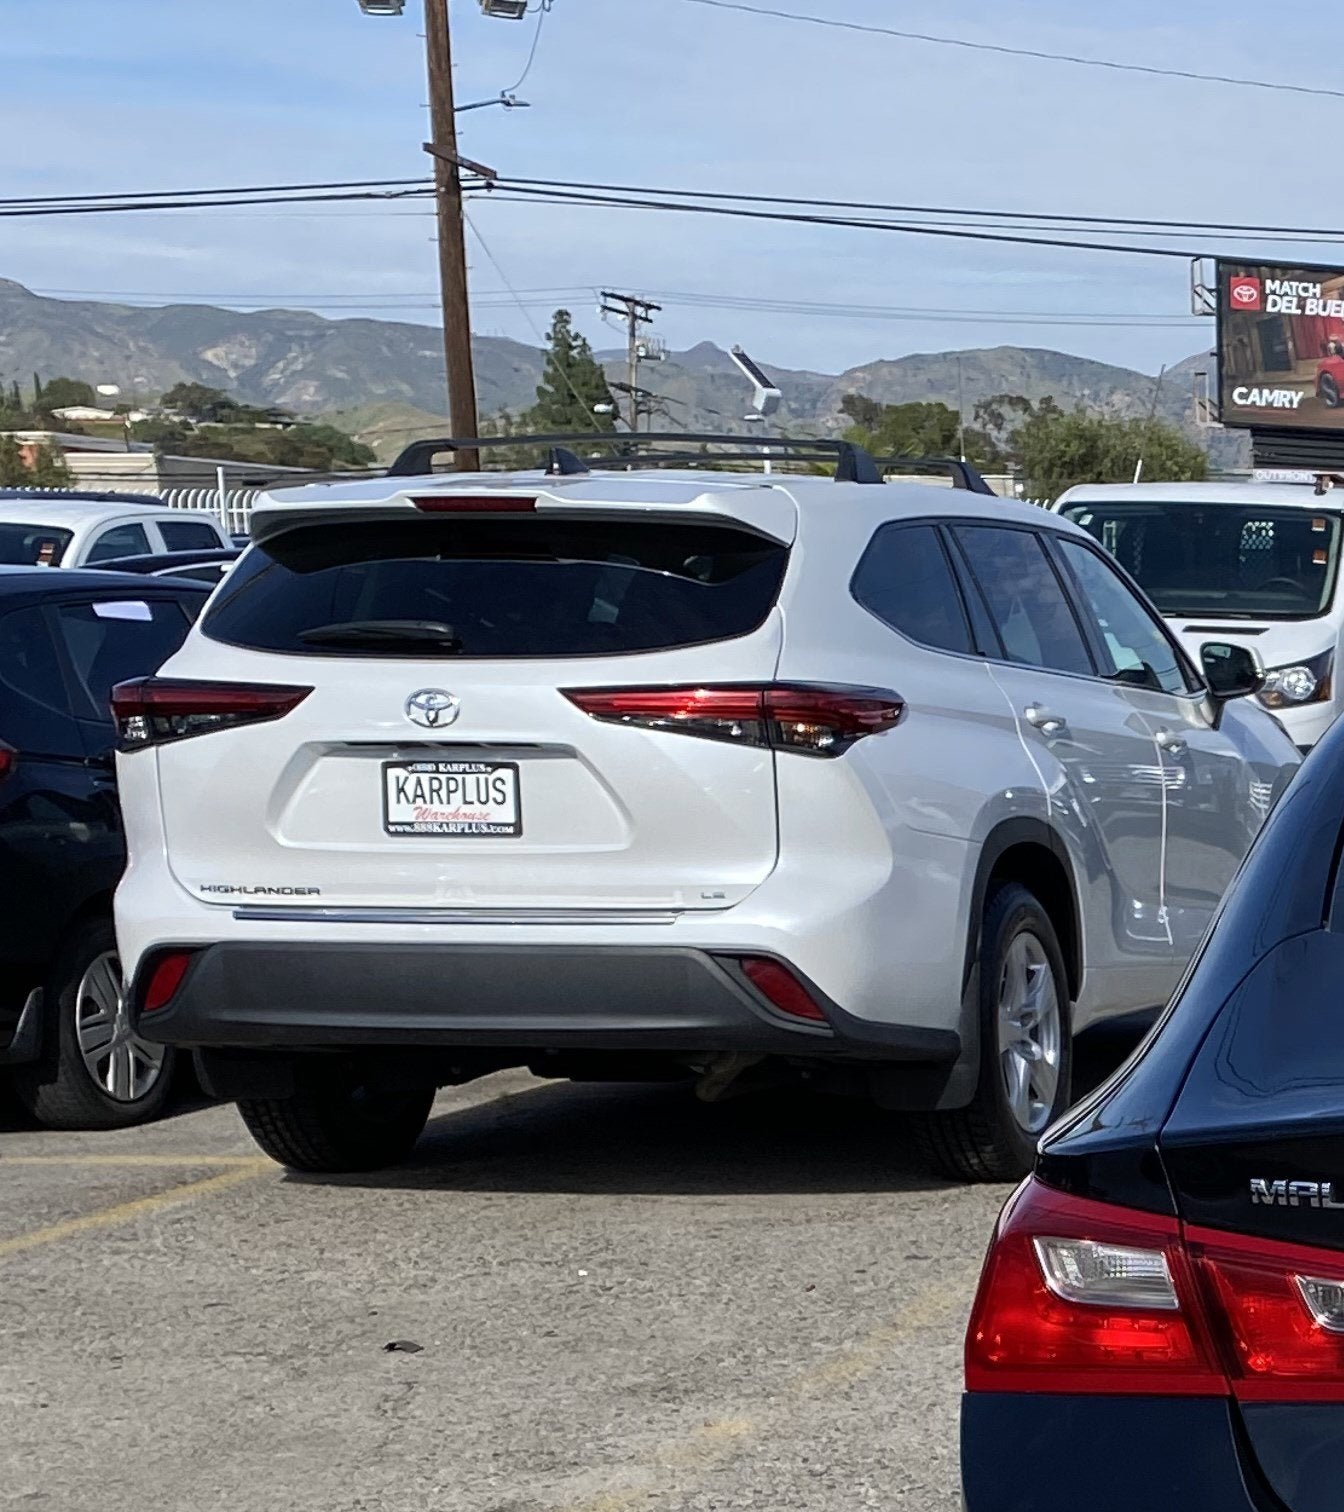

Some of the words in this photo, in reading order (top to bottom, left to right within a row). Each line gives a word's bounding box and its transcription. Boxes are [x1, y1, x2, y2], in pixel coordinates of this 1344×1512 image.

[1265, 279, 1321, 299] MATCH
[1265, 295, 1301, 315] DEL
[1232, 386, 1304, 409] CAMRY
[438, 762, 486, 773] KARPLUS
[395, 775, 507, 805] KARPLUS
[412, 806, 491, 821] Warehouse
[200, 884, 321, 895] HIGHLANDER
